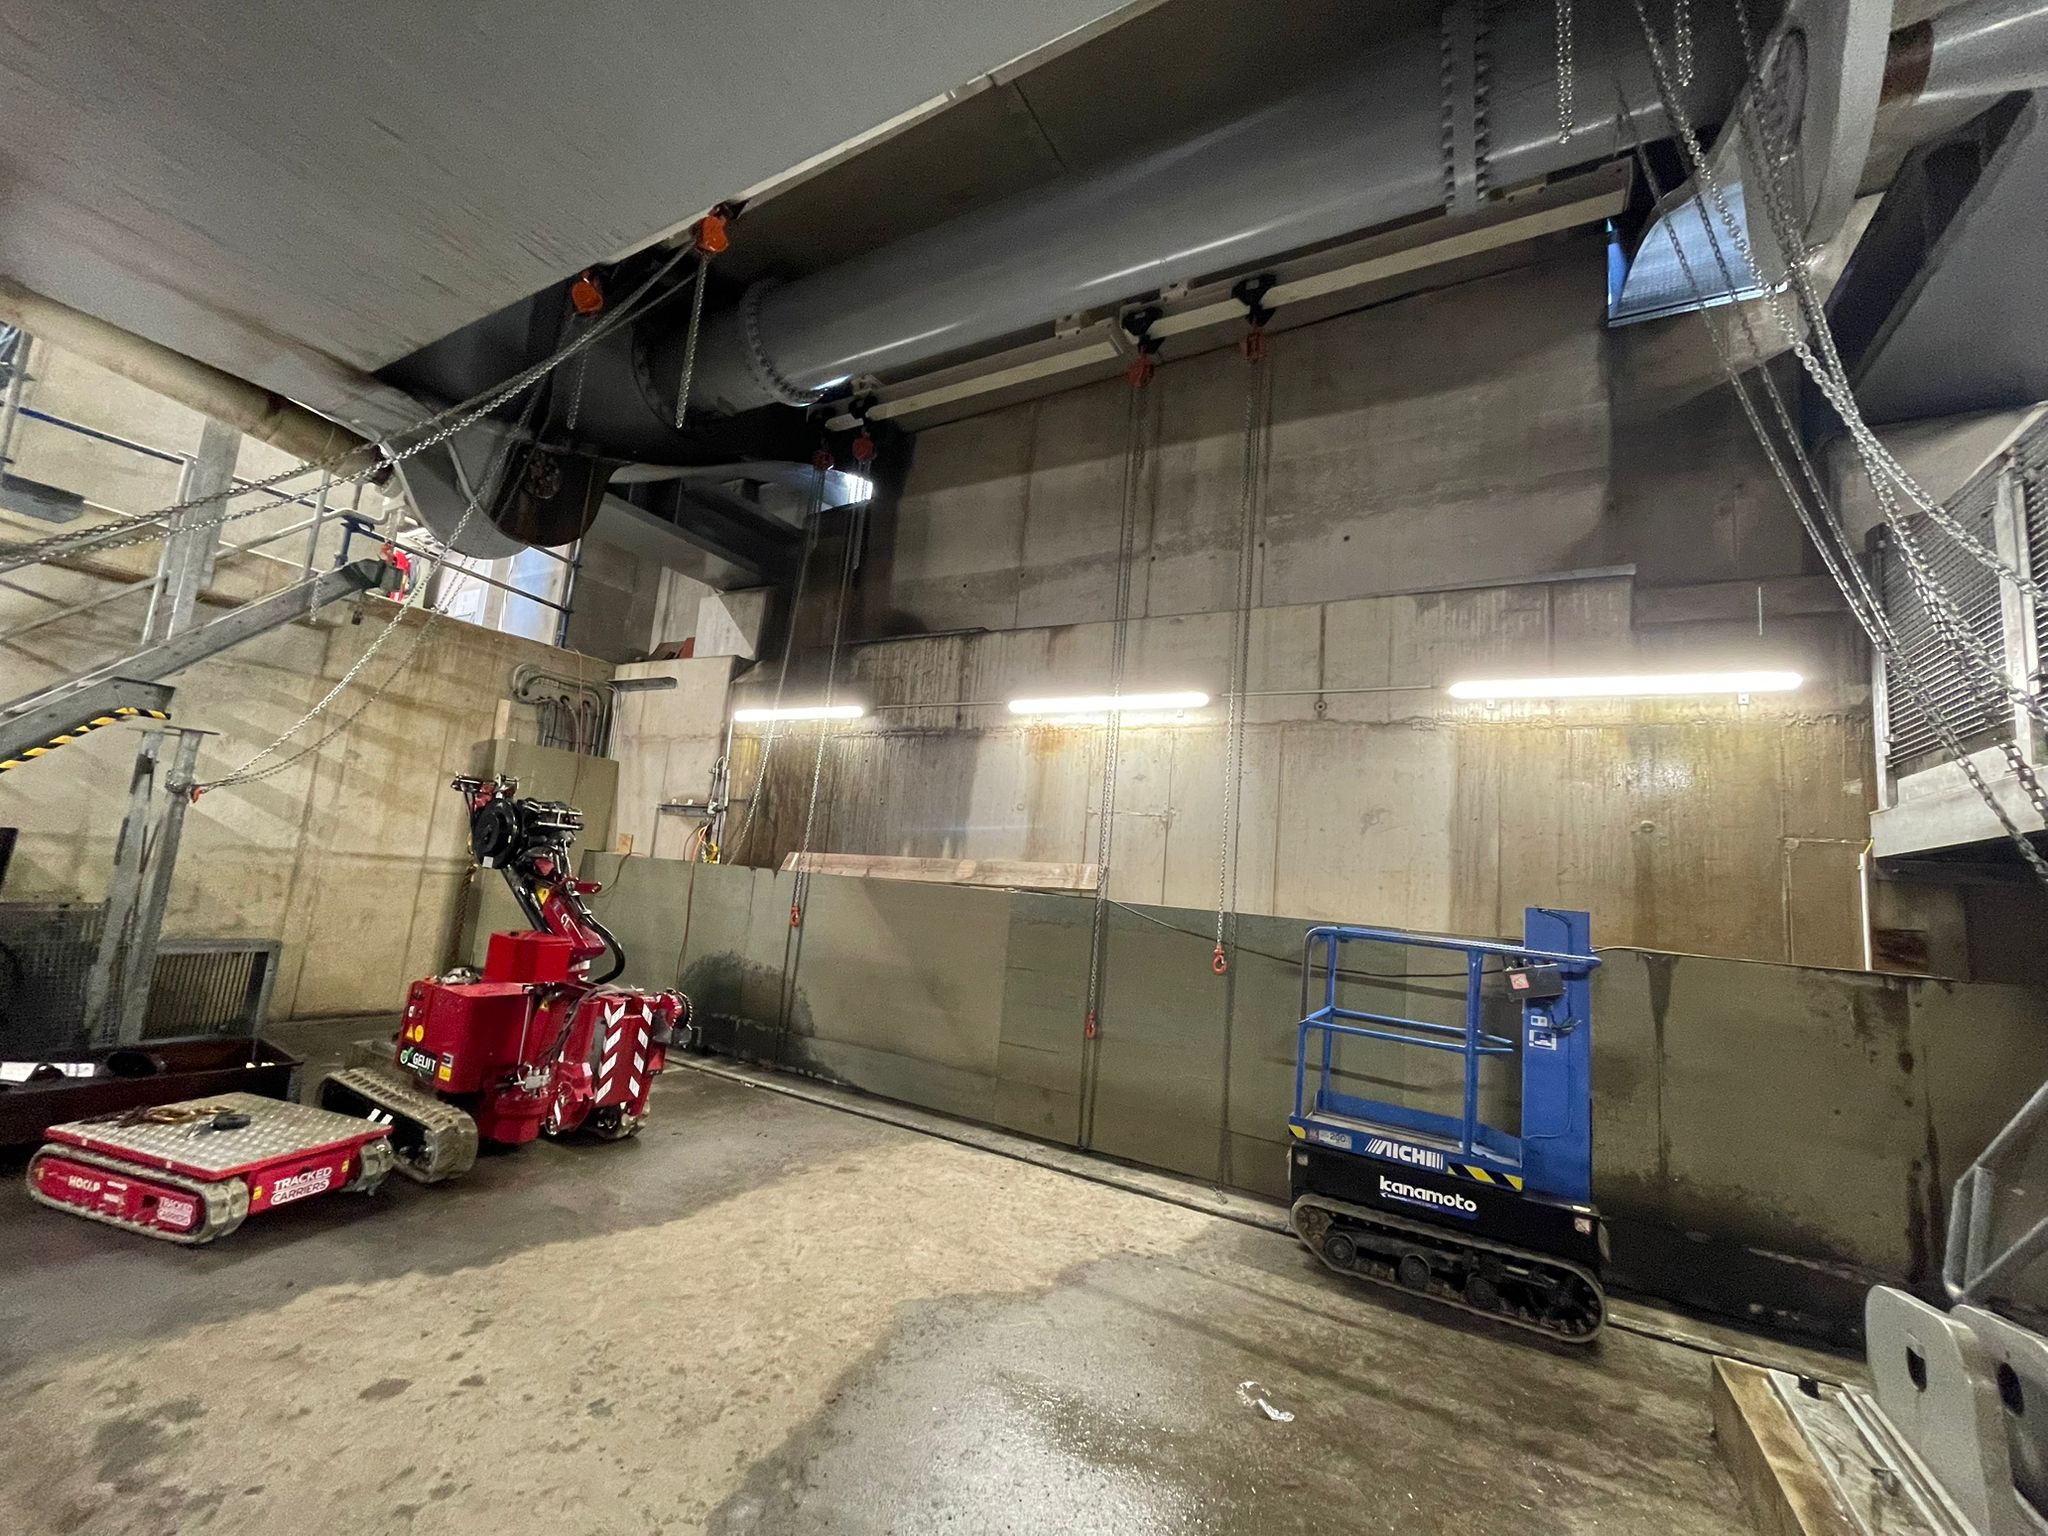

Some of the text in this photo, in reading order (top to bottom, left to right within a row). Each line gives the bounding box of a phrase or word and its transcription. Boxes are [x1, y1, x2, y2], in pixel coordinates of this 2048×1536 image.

[1364, 1138, 1444, 1170] AICHI
[271, 1180, 330, 1205] CARRIERS
[273, 1167, 333, 1193] TRACKED
[1379, 1175, 1478, 1212] kanamoto
